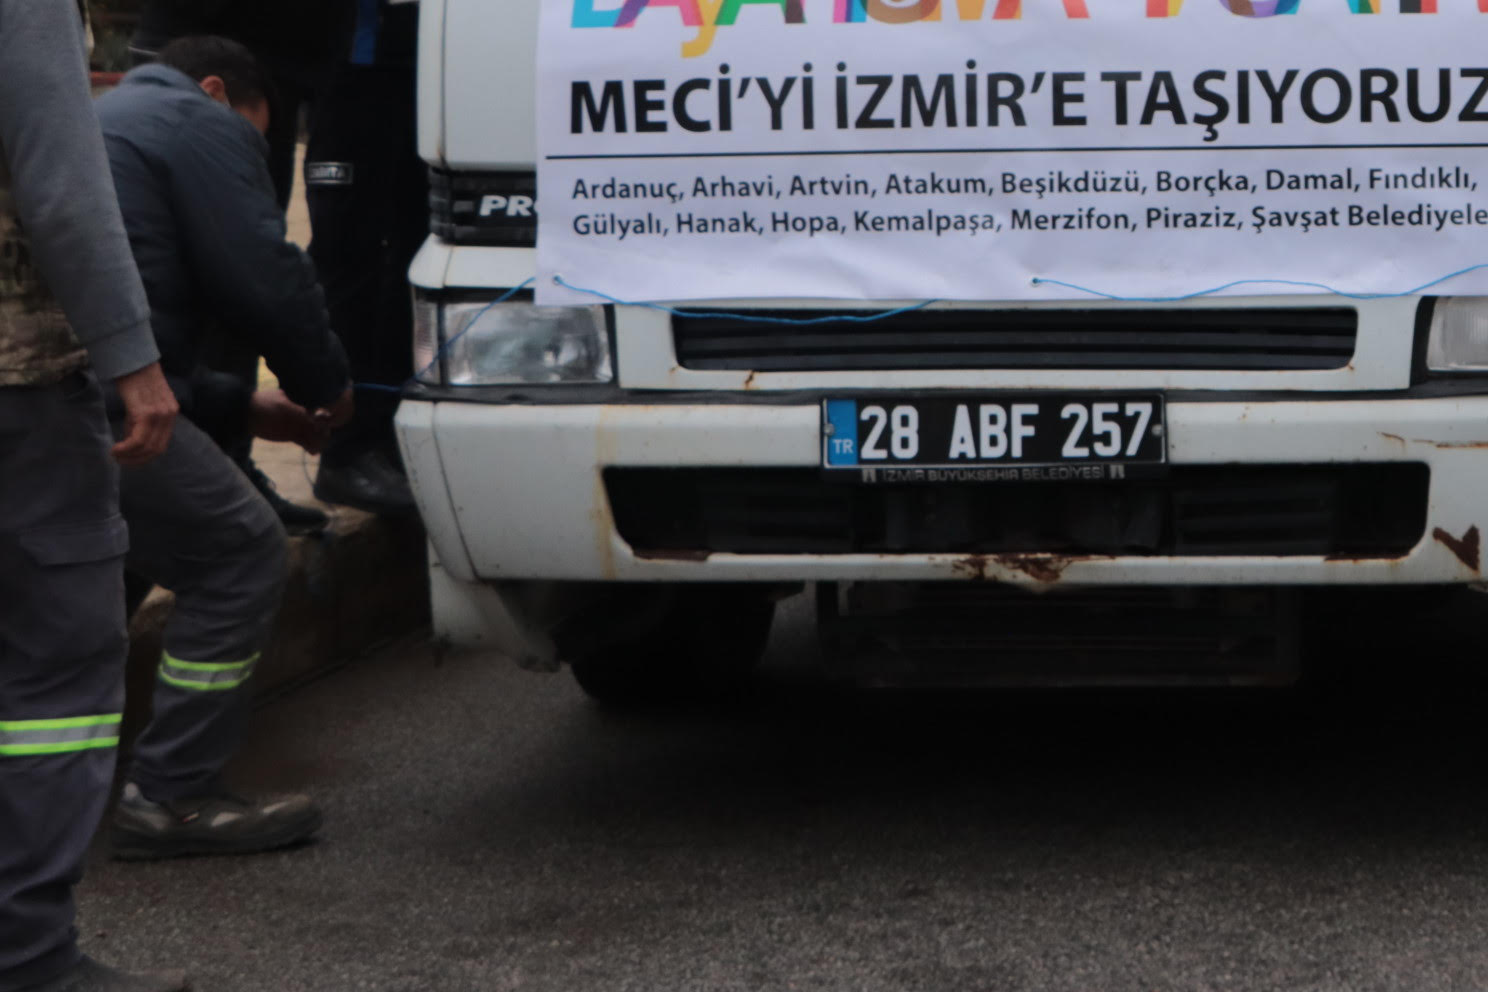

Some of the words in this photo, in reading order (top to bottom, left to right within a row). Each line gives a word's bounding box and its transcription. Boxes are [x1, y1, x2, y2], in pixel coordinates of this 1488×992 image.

[570, 62, 815, 135] MECİ'Yİ
[571, 176, 685, 204] Ardanuç,
[691, 174, 782, 200] Arhavi,
[788, 173, 877, 199] Artvin,
[884, 171, 995, 199] Atakum,
[1001, 169, 1148, 200] Beşikdüzü,
[1156, 168, 1258, 198] Borçka,
[1265, 167, 1361, 194] Damal,
[1368, 165, 1478, 192] Fındıklı,
[478, 194, 537, 217] PR
[572, 211, 670, 241] Gülyalı,
[675, 210, 765, 236] Hanak,
[770, 210, 847, 238] Hopa,
[853, 208, 1002, 237] Kemalpaşa,
[1010, 206, 1138, 233] Merzifon,
[1145, 204, 1244, 231] Piraziz,
[1251, 205, 1340, 234] Şavşat
[833, 438, 854, 454] TR
[859, 405, 919, 460] 28
[948, 403, 1039, 459] ABF
[1060, 402, 1153, 458] 257
